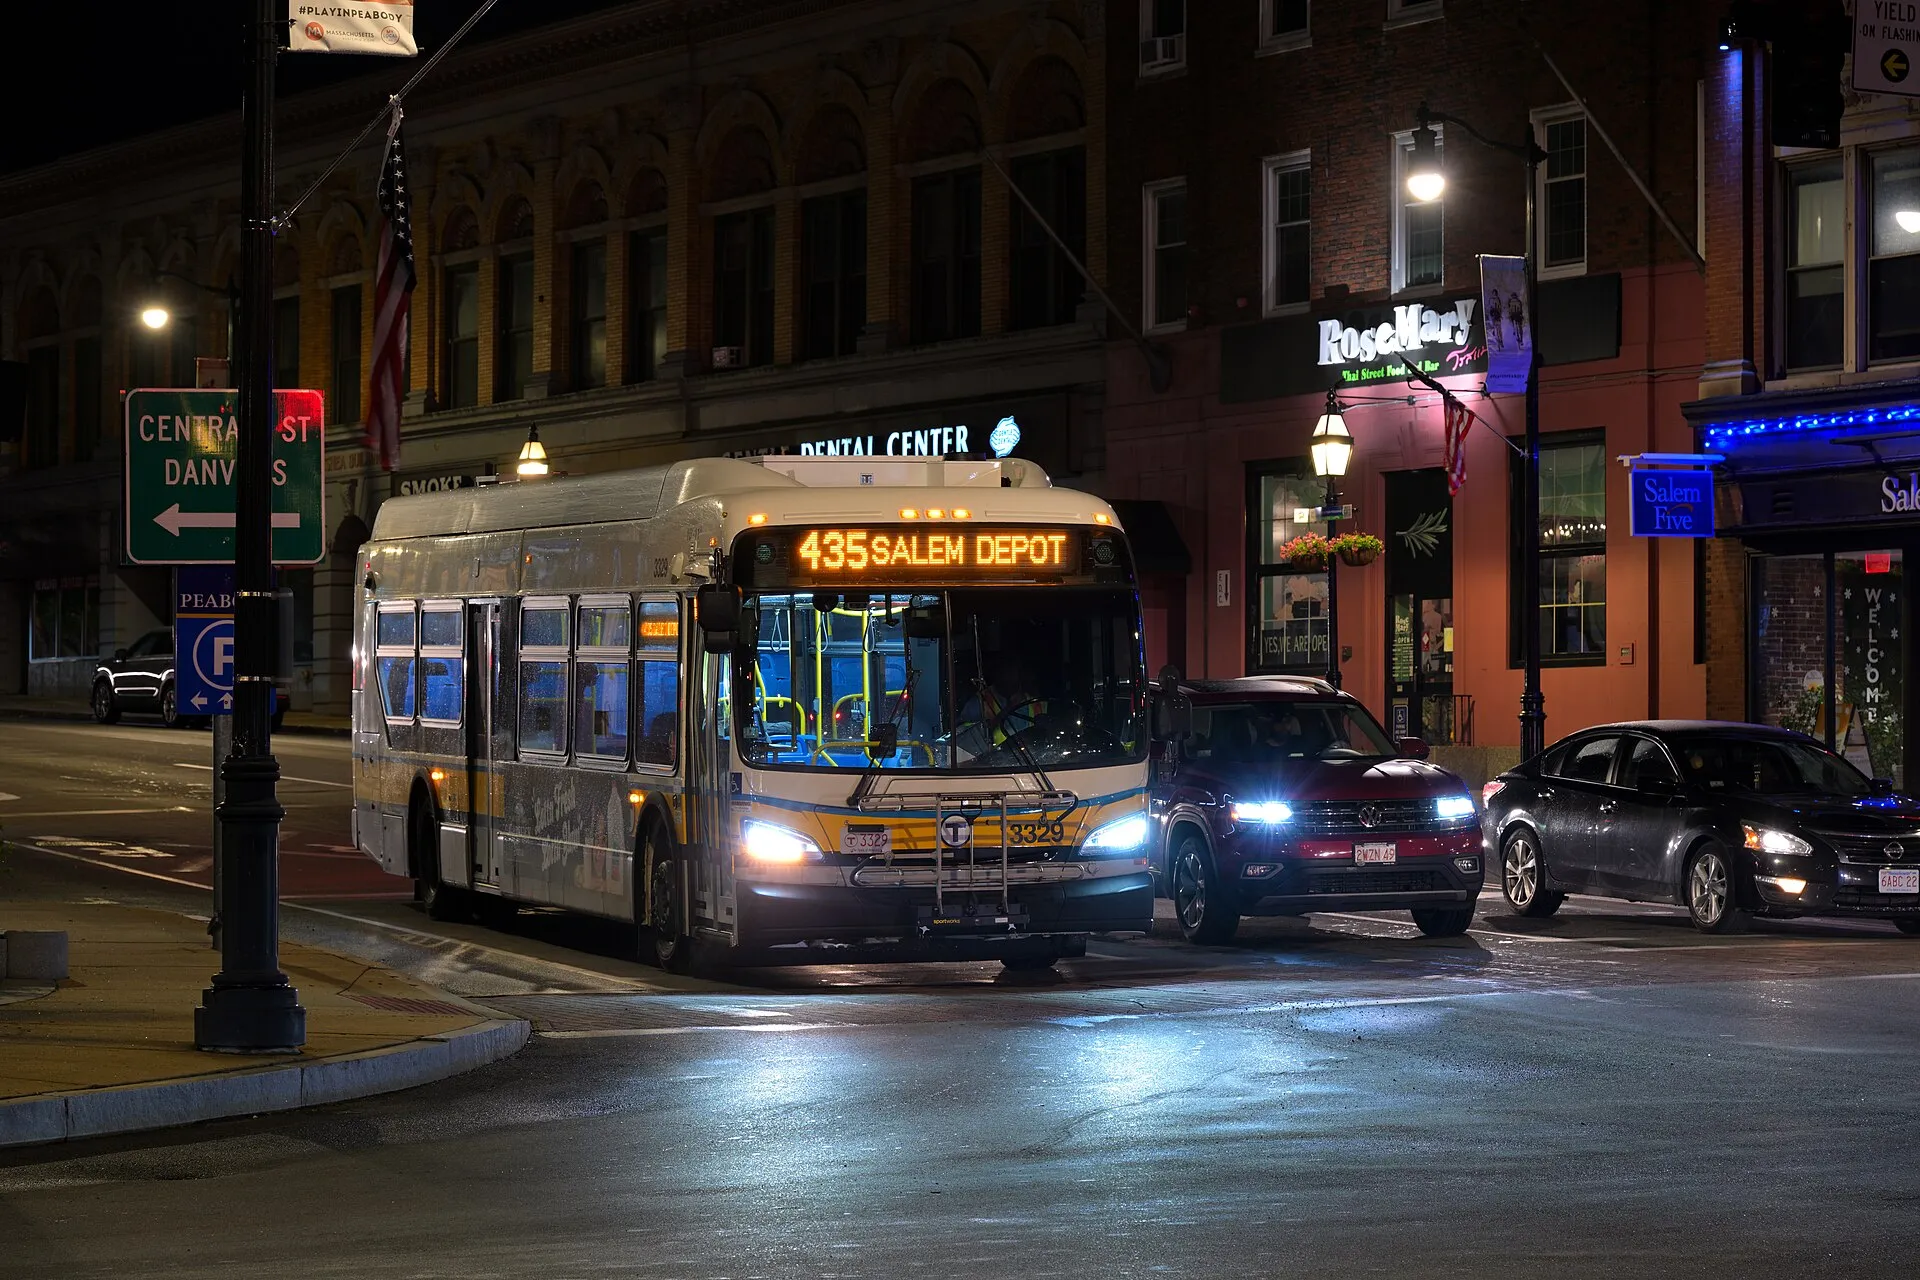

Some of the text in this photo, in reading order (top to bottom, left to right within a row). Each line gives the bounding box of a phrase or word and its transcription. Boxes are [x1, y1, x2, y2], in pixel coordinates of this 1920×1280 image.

[299, 6, 403, 22] #PLAYINPEABODY
[1874, 1, 1916, 22] YIELD
[326, 30, 375, 38] MASSACHUSETTS
[1863, 24, 1876, 38] ON
[1317, 299, 1477, 365] RoseMary
[1342, 370, 1359, 382] Thai
[1361, 365, 1385, 381] Street
[1387, 363, 1405, 377] Food
[1425, 360, 1440, 372] Bar
[139, 415, 311, 443] CENTRA ST
[887, 425, 968, 456] CENTER
[165, 459, 287, 486] DANVS
[1644, 476, 1701, 502] Salem
[1654, 505, 1692, 530] Five
[799, 532, 1066, 569] 435 SALEM DEPOT
[180, 593, 235, 608] PEAB
[1311, 634, 1328, 651] OPE
[860, 833, 888, 847] 3329
[1009, 822, 1065, 845] 3329
[1357, 848, 1394, 860] 2WZN 49
[1881, 876, 1917, 887] 6ABC 22
